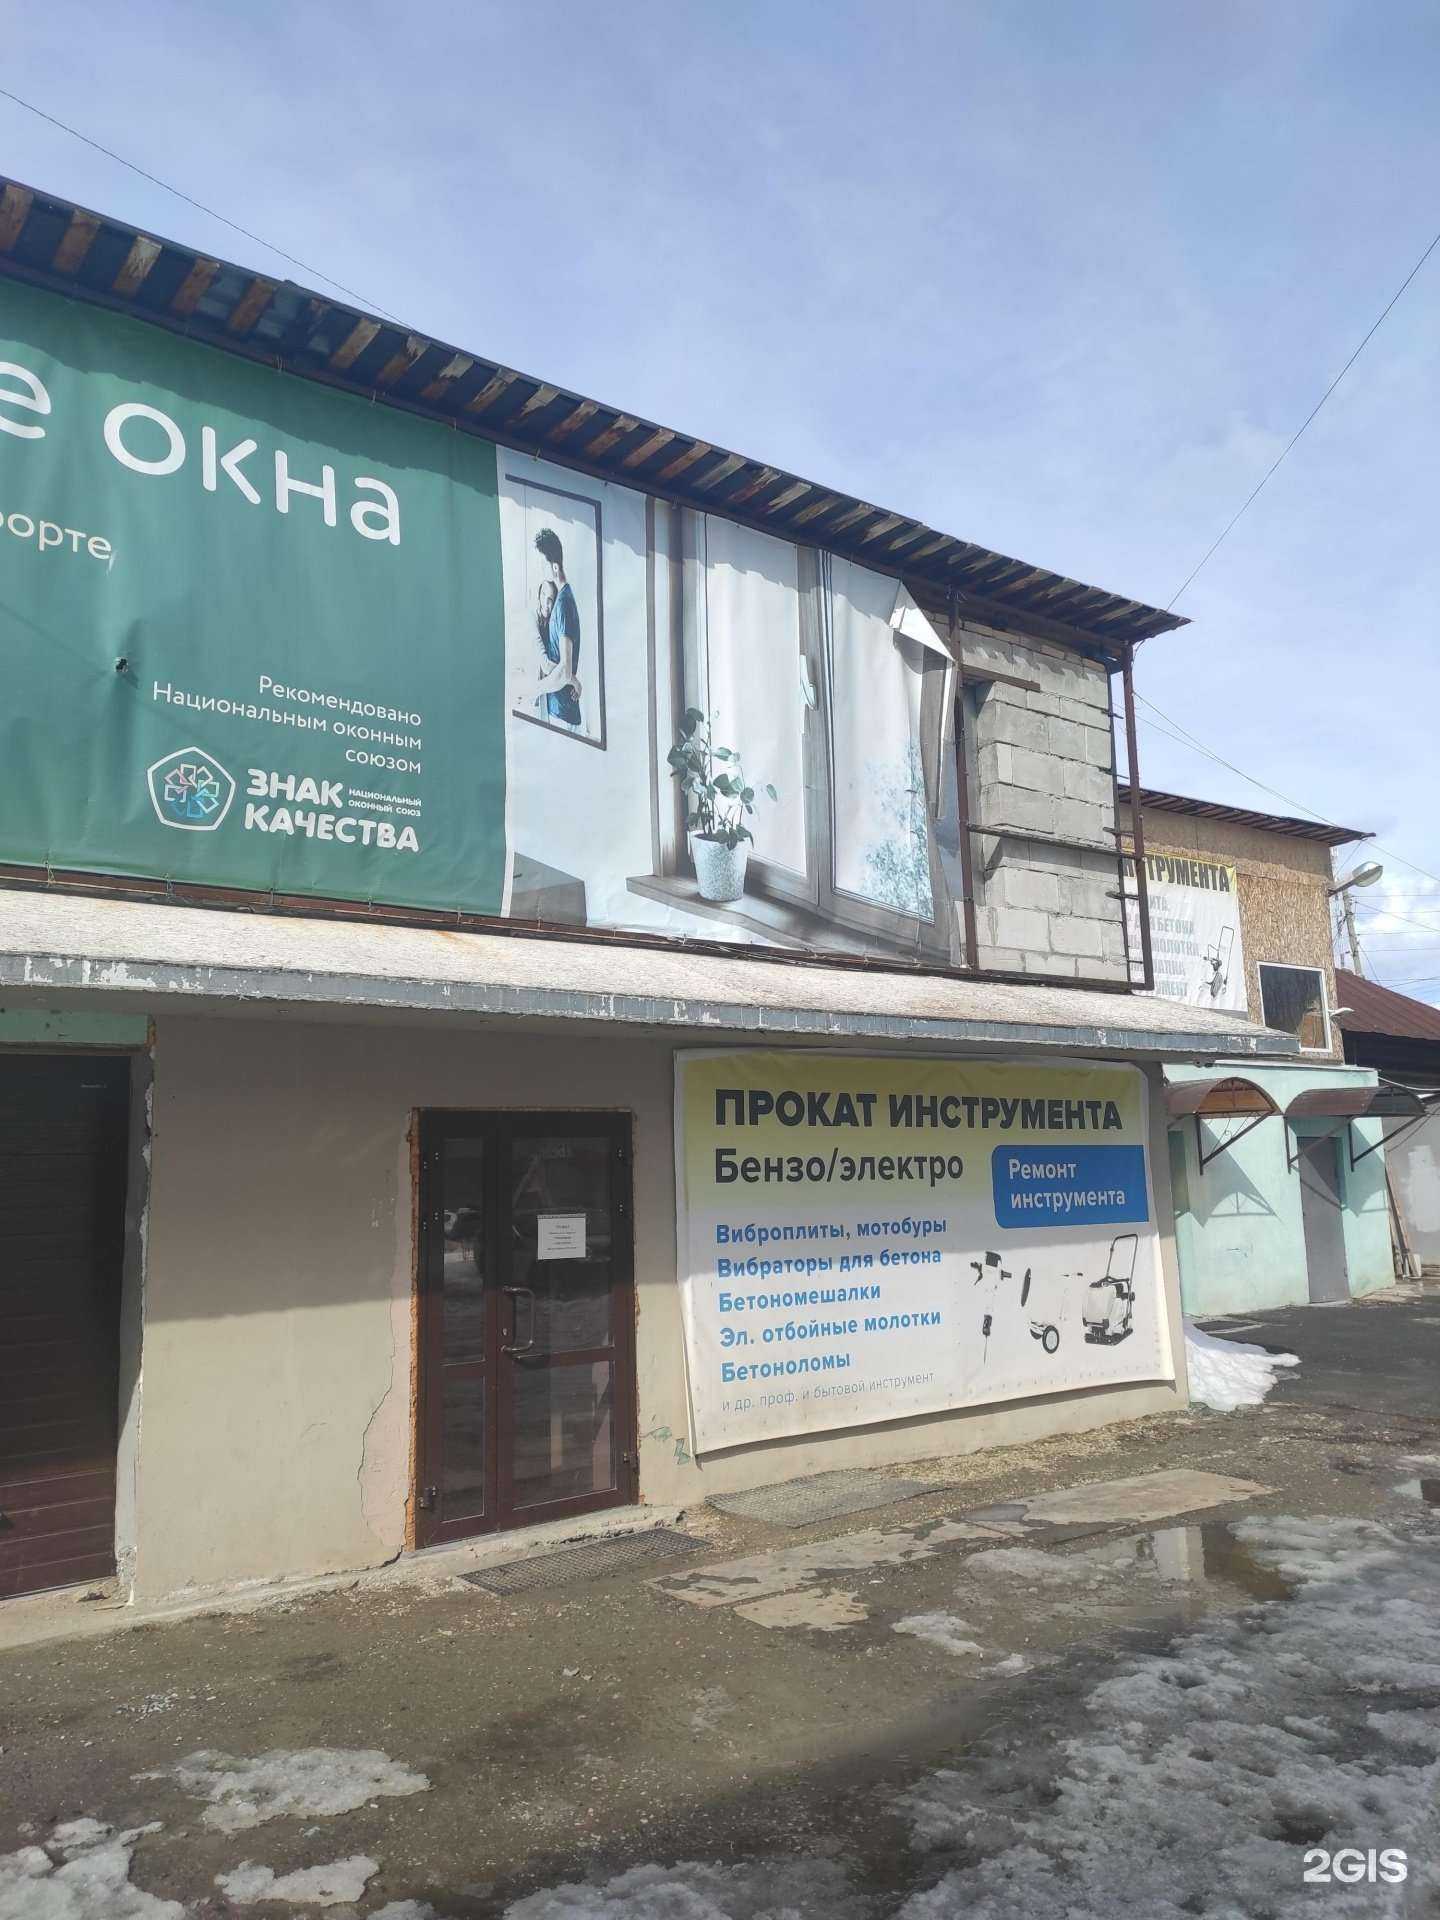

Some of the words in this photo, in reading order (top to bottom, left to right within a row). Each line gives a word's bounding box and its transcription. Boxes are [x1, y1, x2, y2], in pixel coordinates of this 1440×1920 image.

[103, 402, 400, 546] окна
[0, 511, 112, 560] орте
[152, 681, 327, 731] Национальным
[333, 722, 422, 750] оконным
[259, 675, 421, 726] Рекомендовано
[345, 749, 421, 774] союзом
[246, 768, 343, 809] ЗНАК
[348, 788, 422, 807] НАЦИОНАЛЬНЫЙ
[348, 799, 393, 814] ОКОННЫЙ
[395, 806, 421, 817] СОЮЗ
[244, 803, 420, 853] КАЧЕСТВА
[1145, 855, 1230, 893] ТРУМЕНТА
[715, 1089, 877, 1127] ПРОКАТ
[889, 1094, 1123, 1130] ИНСТРУМЕНТА
[715, 1147, 964, 1187] Бензо/электро
[1008, 1159, 1077, 1180] Ремонт
[1011, 1190, 1126, 1212] инструмента
[716, 1223, 851, 1246] Виброплиты,
[857, 1217, 947, 1238] мотобуры
[718, 1257, 832, 1279] Вибраторы
[839, 1252, 873, 1272] для
[880, 1249, 942, 1266] бетона
[719, 1285, 881, 1312] Бетономешалки
[720, 1327, 754, 1347] Эл.
[762, 1319, 858, 1343] отбойные
[864, 1311, 941, 1331] молотки
[721, 1352, 851, 1382] Бетоноломы
[722, 1400, 730, 1411] и
[734, 1397, 754, 1412] др.
[760, 1391, 798, 1408] проф.
[802, 1389, 810, 1399] и
[814, 1380, 865, 1400] бытовой
[869, 1371, 934, 1392] инструмент
